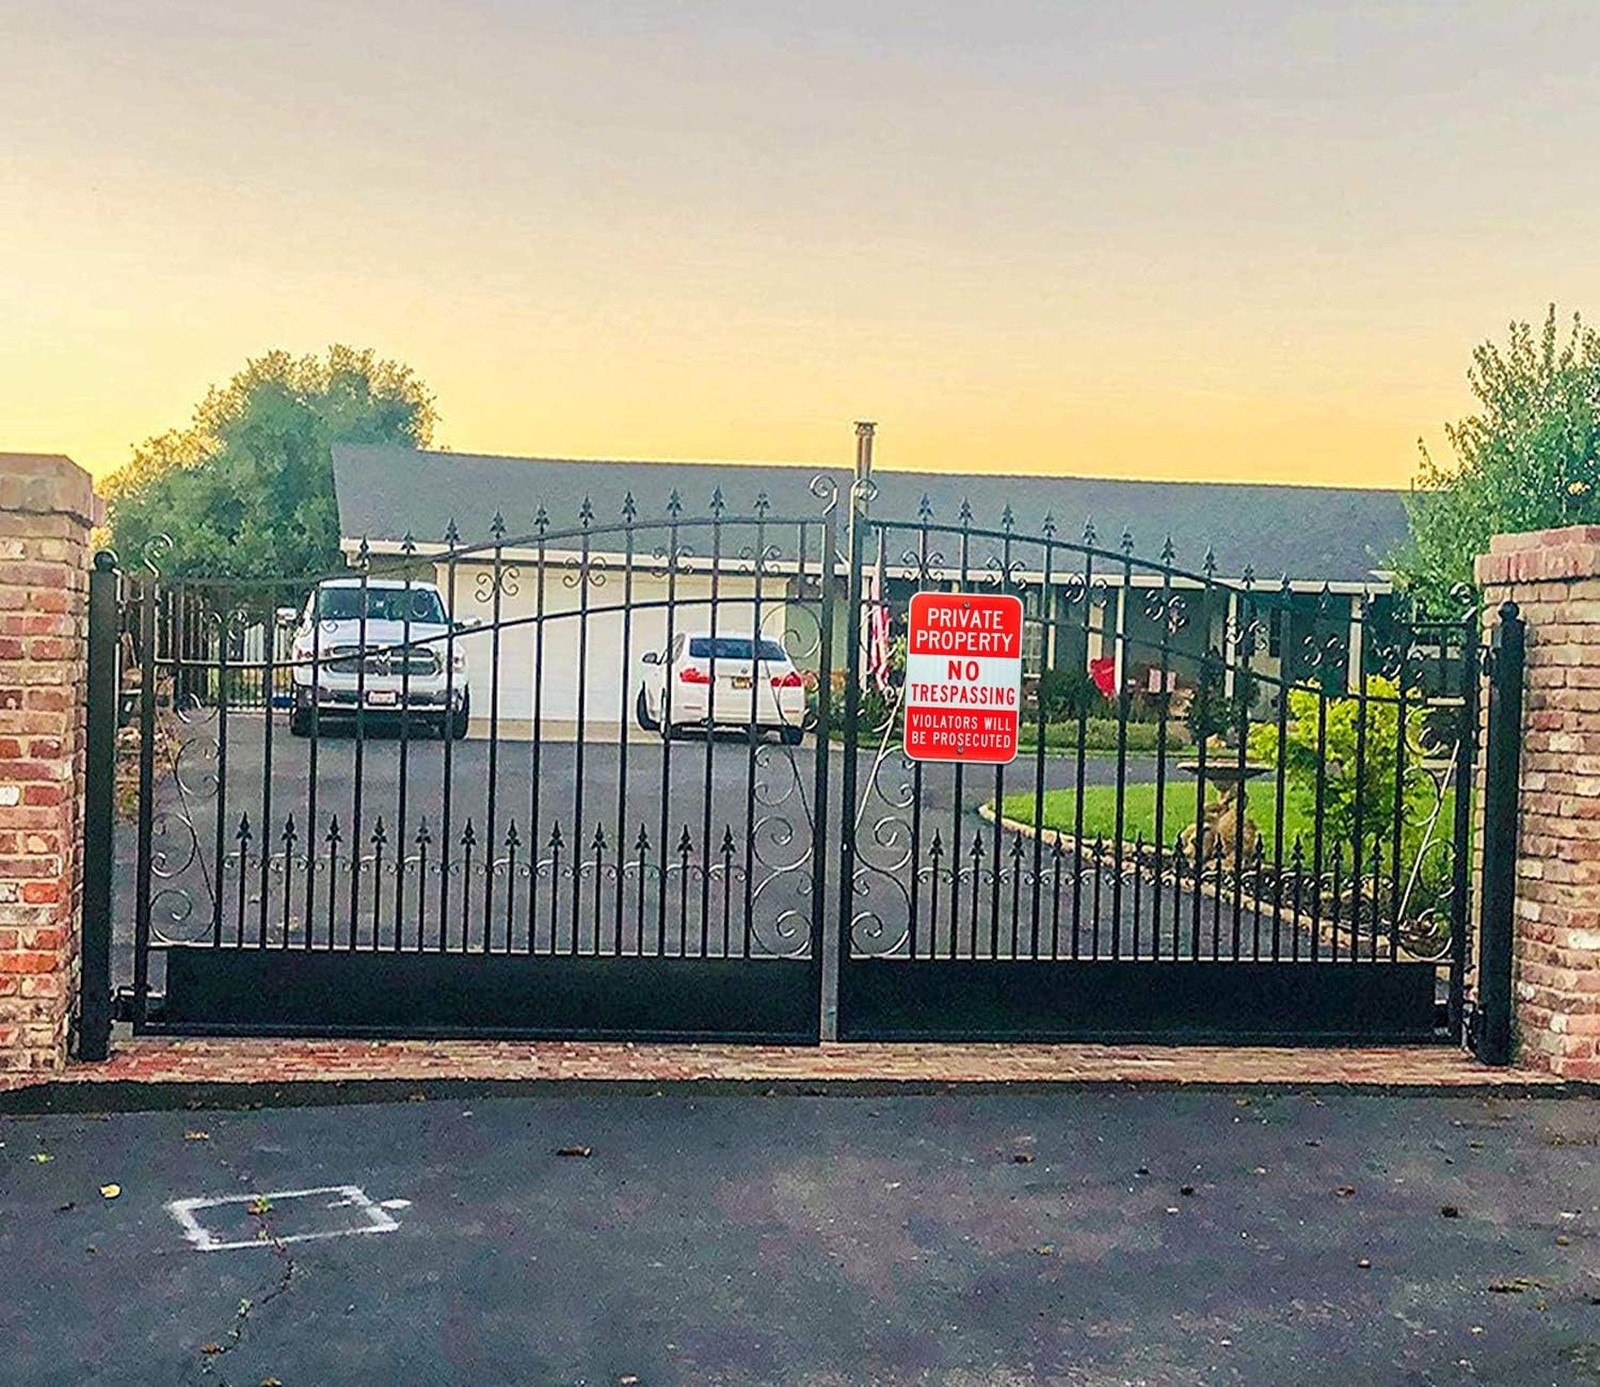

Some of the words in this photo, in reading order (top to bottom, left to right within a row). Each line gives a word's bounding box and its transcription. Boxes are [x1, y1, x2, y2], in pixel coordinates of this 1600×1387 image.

[927, 608, 1004, 629] PRIVATE
[916, 630, 1014, 652] PROPERTY
[947, 660, 980, 681] NO
[911, 684, 1015, 705] TRESPASSING
[912, 714, 978, 730] VIOLATORS
[984, 716, 1012, 731] WILL
[911, 732, 926, 745] BE
[932, 732, 1011, 748] PROSECUTED
